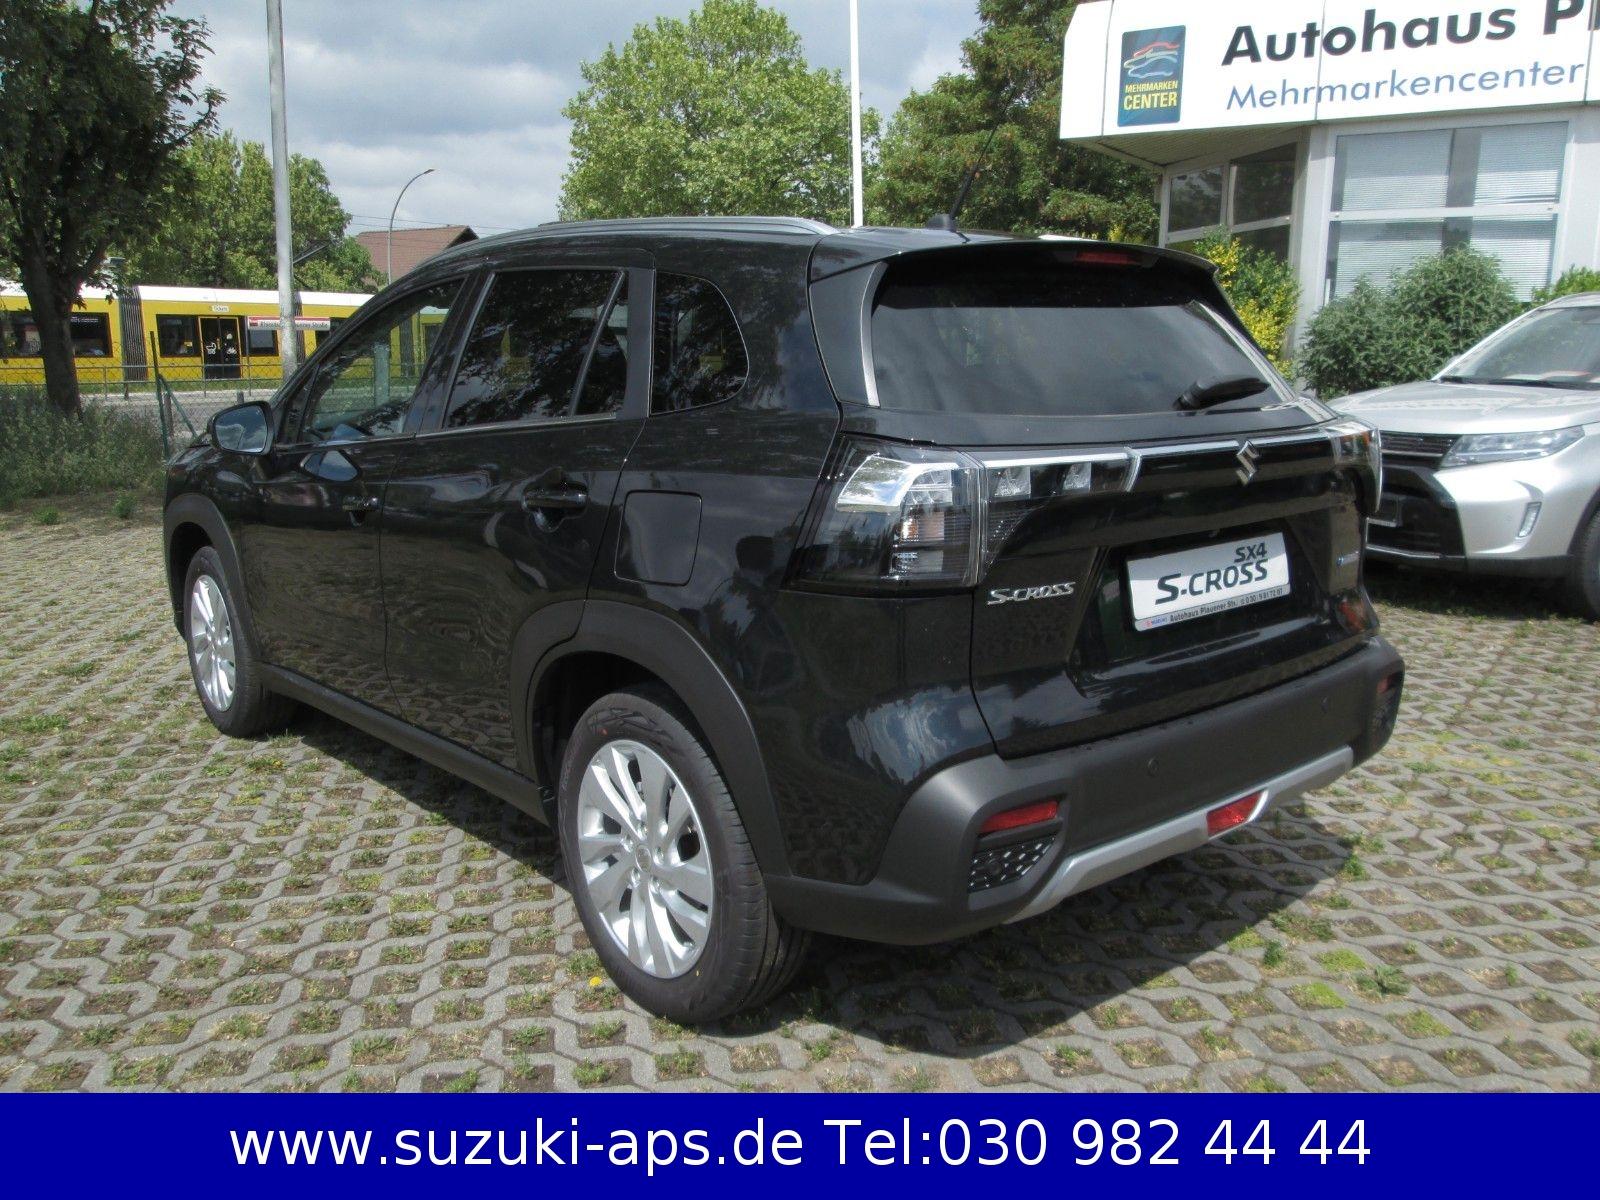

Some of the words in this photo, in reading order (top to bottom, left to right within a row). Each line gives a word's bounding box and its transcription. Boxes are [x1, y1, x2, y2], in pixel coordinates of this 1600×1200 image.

[1221, 8, 1516, 66] Autohaus
[1125, 80, 1178, 94] MEHRMARKEN
[1226, 62, 1585, 111] Mehrmarkencenter
[1123, 91, 1178, 110] CENTER
[1234, 542, 1268, 563] SX4
